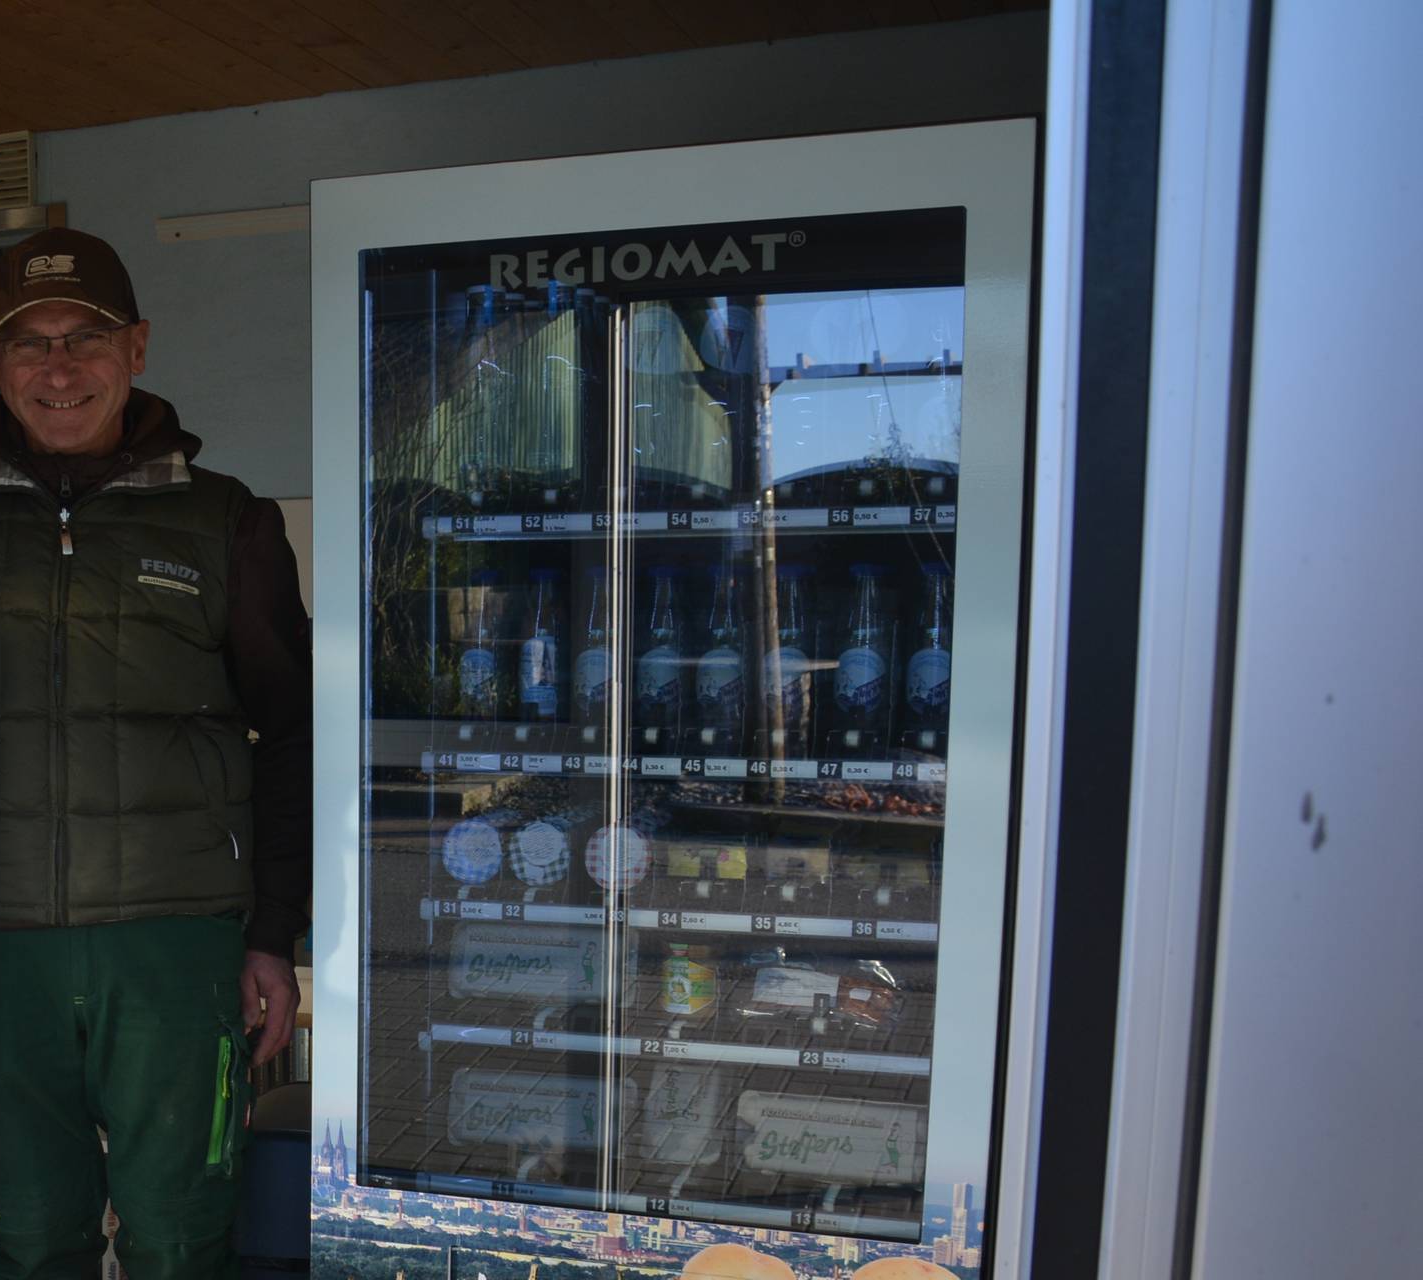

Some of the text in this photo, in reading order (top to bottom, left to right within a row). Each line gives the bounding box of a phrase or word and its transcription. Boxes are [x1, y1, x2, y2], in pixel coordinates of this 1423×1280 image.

[596, 514, 610, 527] 53
[672, 513, 687, 525] 54
[742, 512, 758, 523] 55
[832, 510, 849, 522] 56
[914, 509, 931, 521] 57
[456, 518, 470, 530] 51
[525, 516, 541, 528] 52
[140, 558, 201, 583] FENDT
[439, 754, 453, 766] 41
[504, 756, 519, 768] 42
[565, 757, 581, 769] 43
[622, 759, 638, 770] 44
[685, 760, 701, 772] 45
[750, 762, 766, 774] 46
[821, 764, 837, 776] 47
[896, 765, 913, 777] 48
[442, 902, 457, 913] 31
[506, 905, 521, 917] 32
[662, 913, 678, 925] 34
[755, 917, 771, 929] 35
[856, 922, 873, 935] 36
[515, 1032, 529, 1044] 21
[644, 1041, 660, 1053] 22
[803, 1052, 819, 1064] 23
[496, 1184, 510, 1194] 11
[650, 1199, 665, 1211] 12
[795, 1213, 811, 1225] 13
